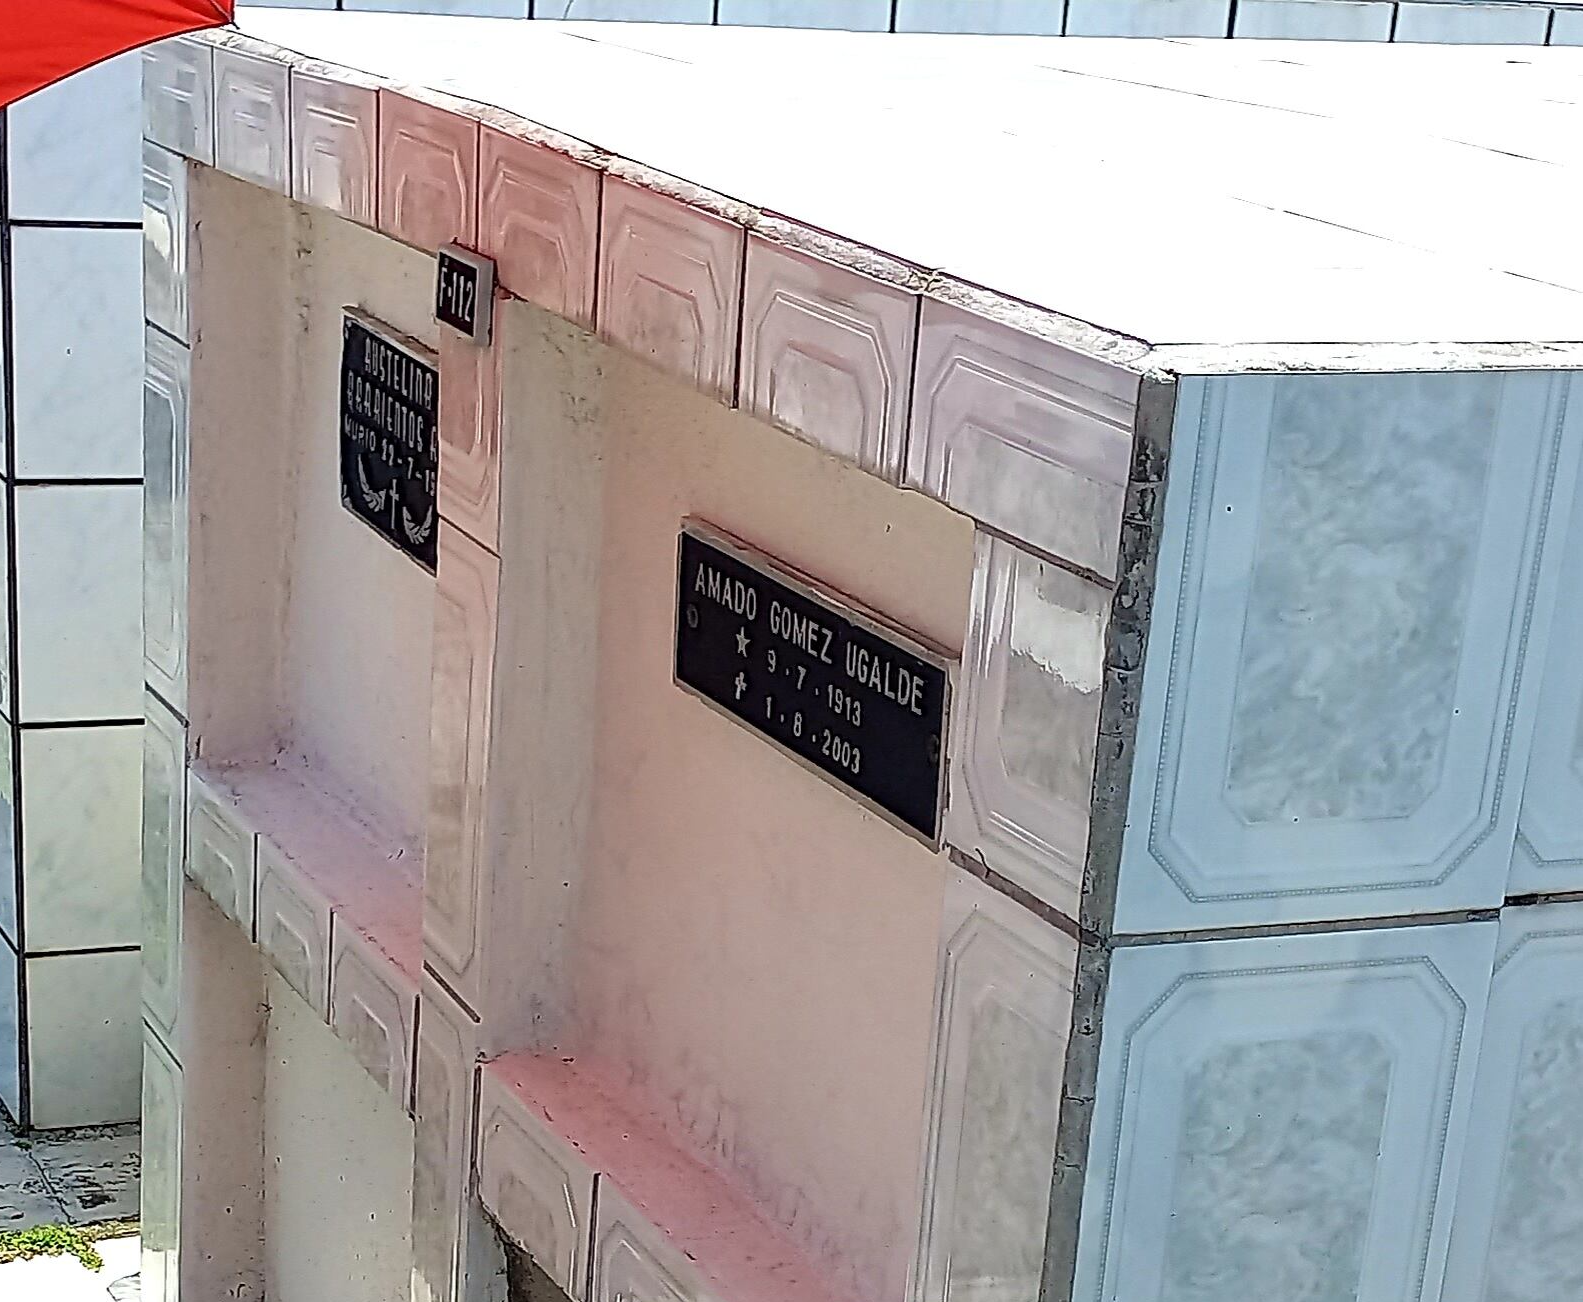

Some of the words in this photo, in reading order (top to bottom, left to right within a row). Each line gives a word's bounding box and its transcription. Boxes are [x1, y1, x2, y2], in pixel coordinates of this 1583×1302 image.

[439, 265, 474, 323] F-112
[346, 369, 424, 453] BARRIENTOS
[364, 337, 434, 411] AUSTELINA
[344, 413, 377, 452] MURIO
[695, 563, 758, 621] AMADO
[770, 600, 834, 665] GOMEZ
[845, 641, 926, 716] UGALDE
